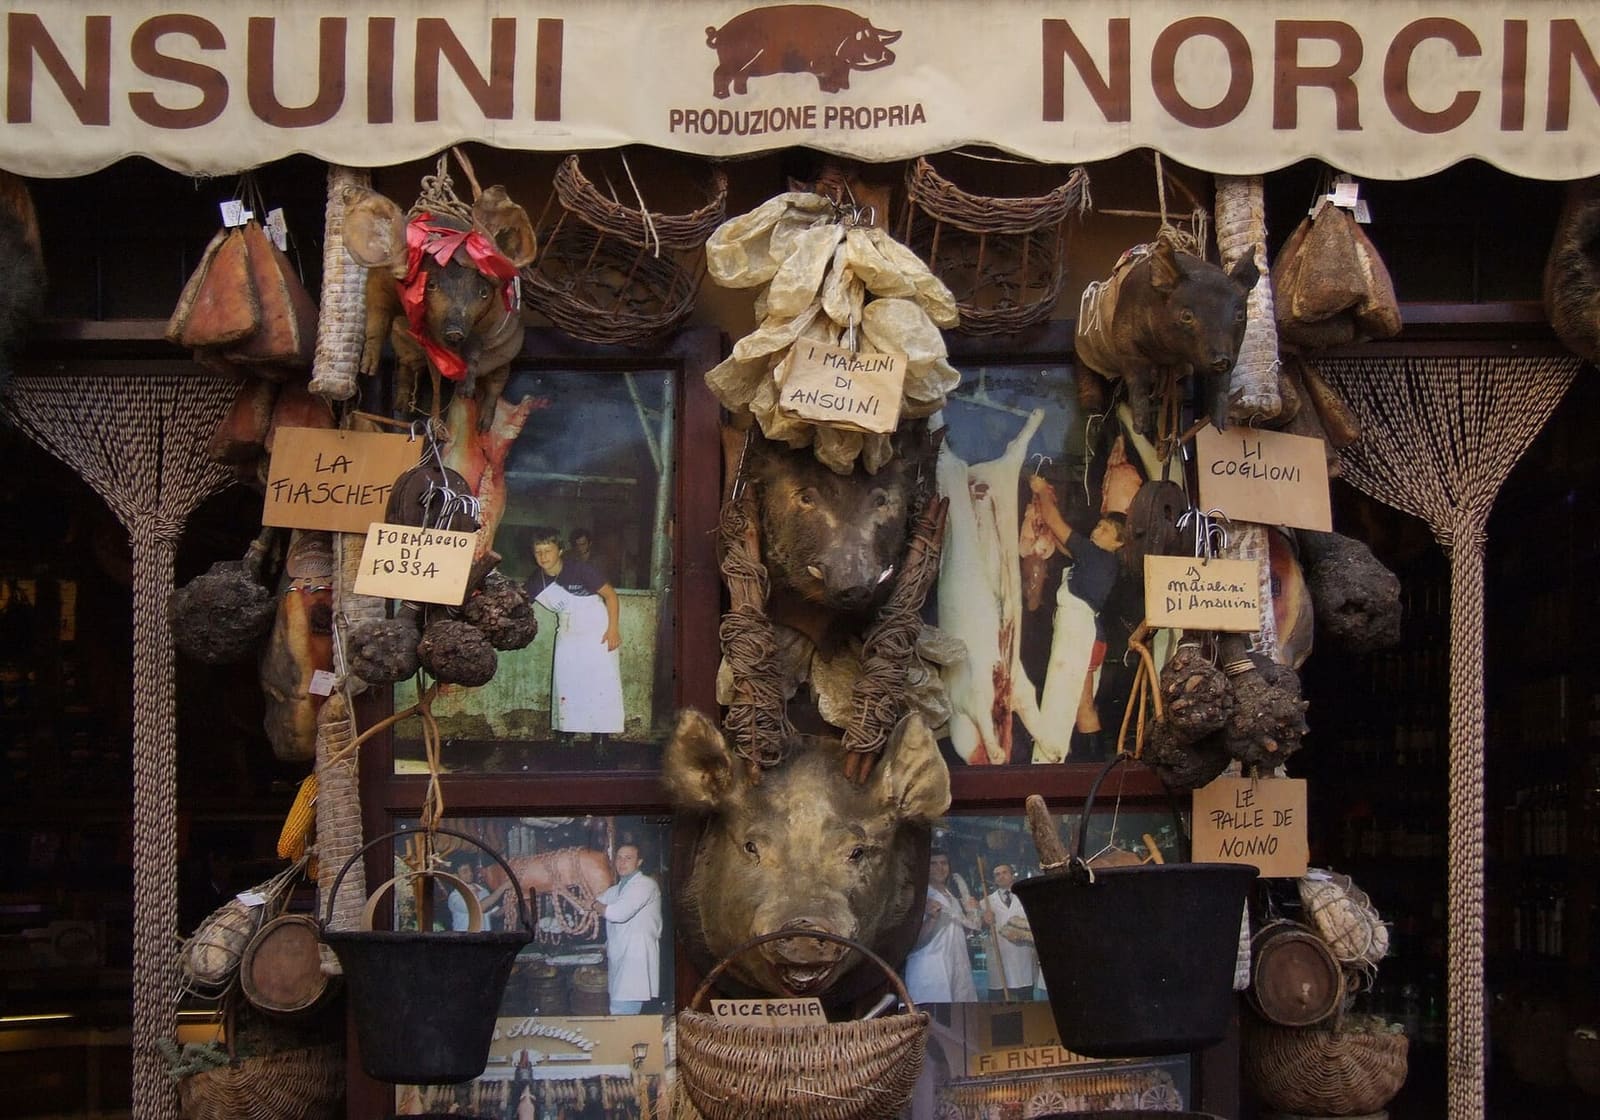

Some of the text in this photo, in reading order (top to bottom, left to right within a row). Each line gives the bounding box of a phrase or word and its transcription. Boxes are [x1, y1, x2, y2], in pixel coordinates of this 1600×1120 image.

[7, 12, 564, 129] NSUINI
[1042, 17, 1600, 134] NORCIN
[669, 103, 926, 136] PRODUZIONE PROPRIA
[835, 376, 852, 390] DI
[790, 389, 879, 416] ANSUINI
[1243, 440, 1261, 460] LI
[315, 453, 353, 473] LA
[1211, 460, 1301, 482] COGLIONI
[271, 478, 392, 505] FIASCHET
[377, 529, 467, 548] FORMAGGIO
[400, 547, 422, 560] DI
[372, 559, 440, 578] FOSSA
[1235, 788, 1255, 809] LE
[1209, 808, 1293, 830] PALLE DE
[1218, 834, 1279, 858] NONNO
[717, 1001, 821, 1017] CICERCHIA
[1007, 1046, 1088, 1069] ANSU
